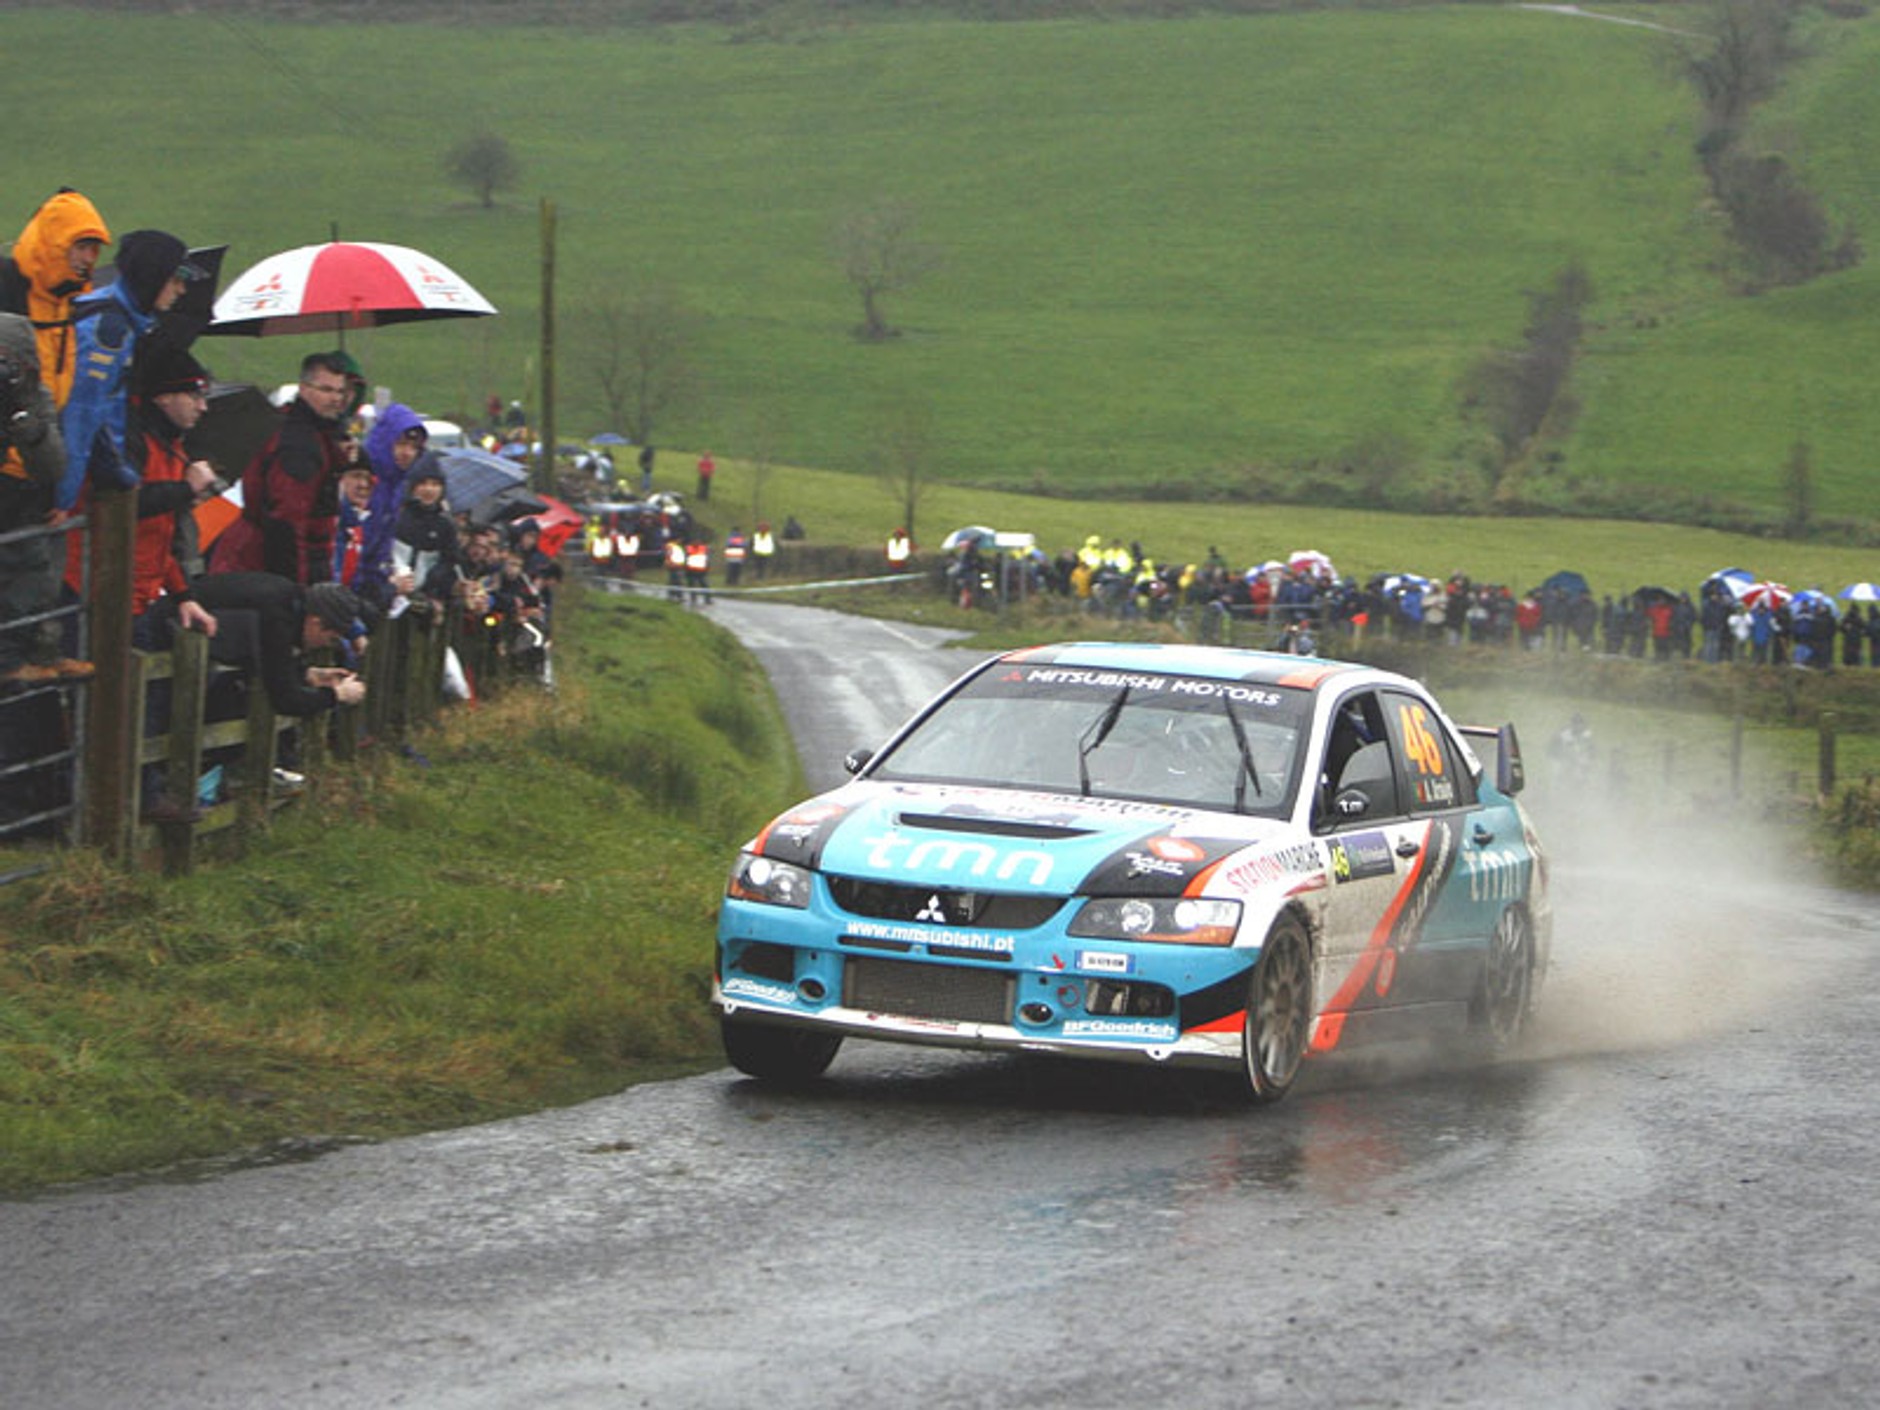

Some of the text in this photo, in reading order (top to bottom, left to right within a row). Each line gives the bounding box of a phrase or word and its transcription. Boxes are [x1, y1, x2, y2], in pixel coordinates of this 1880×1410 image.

[1027, 669, 1283, 707] MITSUBISHI MOTORS
[1400, 704, 1444, 776] 46
[863, 831, 1054, 886] tmn
[1462, 838, 1522, 902] tmn
[846, 921, 1016, 952] www.mitsubishi.pt
